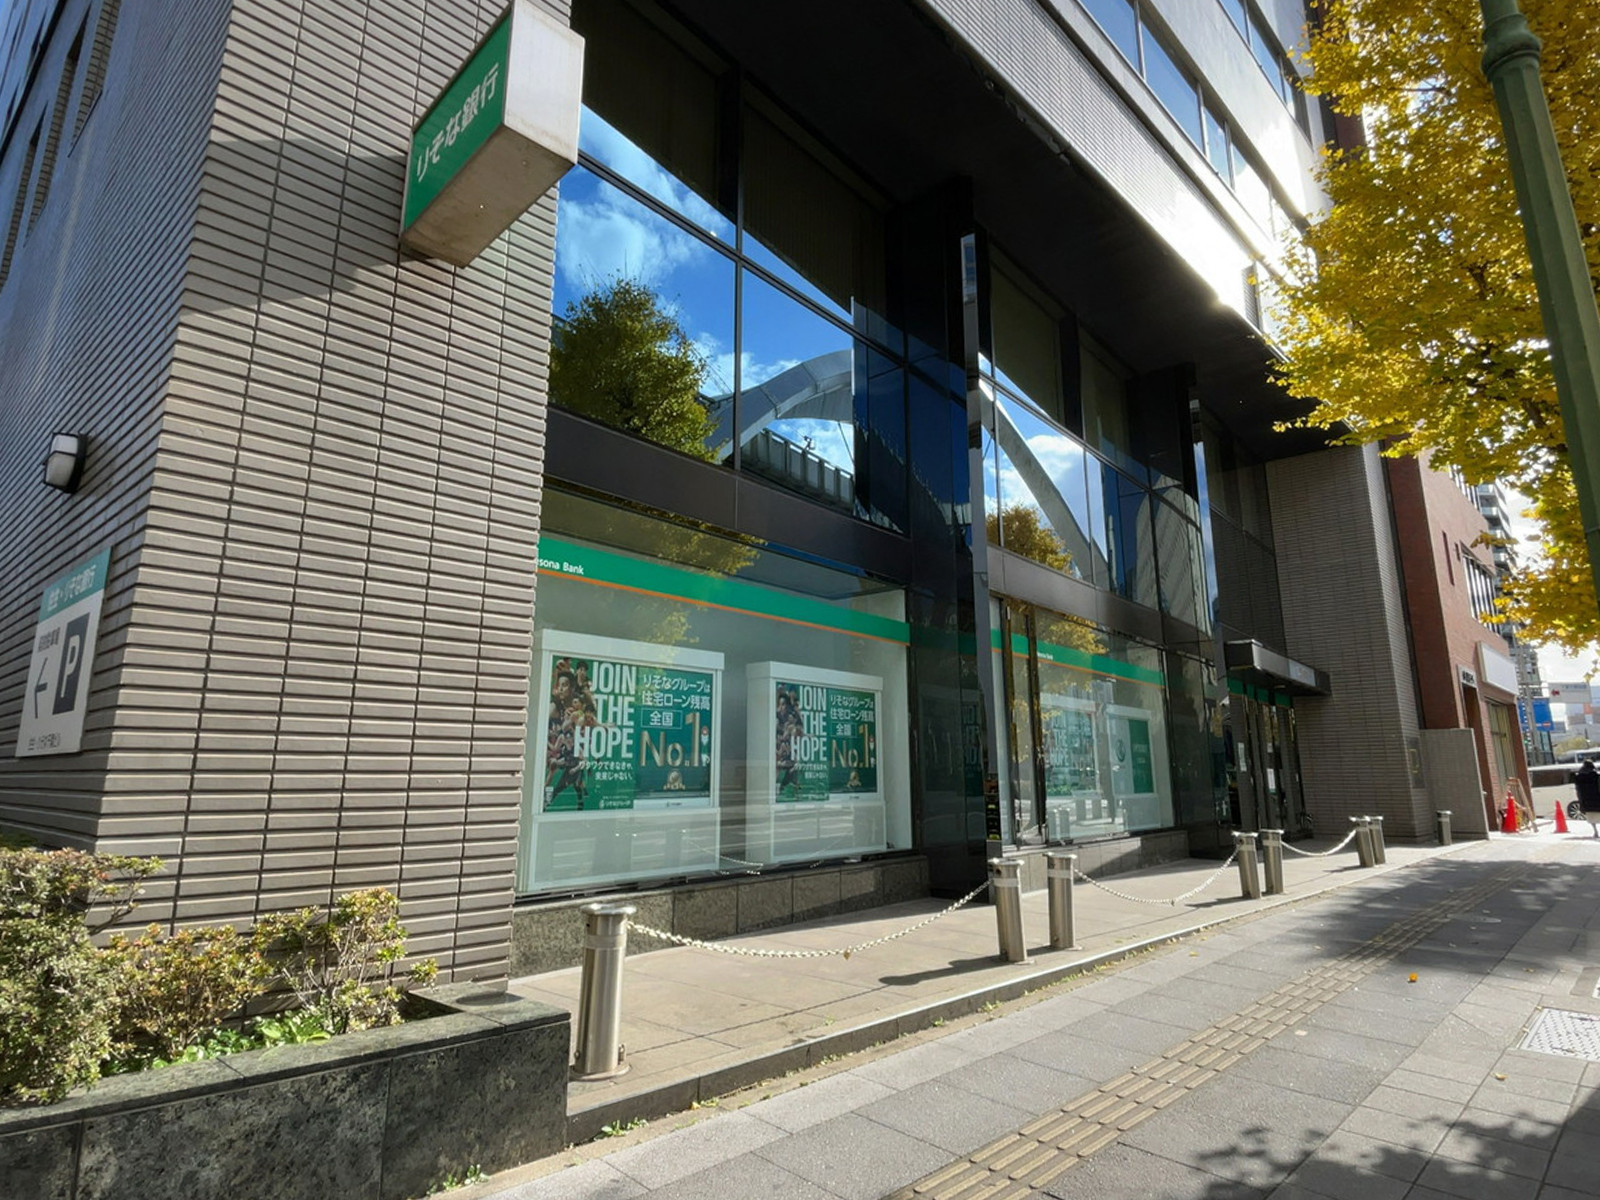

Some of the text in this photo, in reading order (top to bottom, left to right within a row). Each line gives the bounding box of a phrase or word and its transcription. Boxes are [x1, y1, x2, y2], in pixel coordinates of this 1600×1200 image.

[415, 61, 500, 182] りそな銀行
[537, 558, 584, 575] sona Bank
[61, 633, 80, 699] P
[590, 661, 637, 695] JOIN
[643, 674, 711, 693] りそなグループは
[799, 685, 827, 712] JOIN
[594, 693, 635, 727] THE
[642, 690, 711, 710] 住宅ローン残高
[649, 710, 674, 727] 全国
[800, 711, 827, 736] THE
[573, 725, 634, 759] HOPE
[640, 711, 700, 767] No.1
[790, 735, 827, 762] HOPE
[832, 723, 869, 768] No.1
